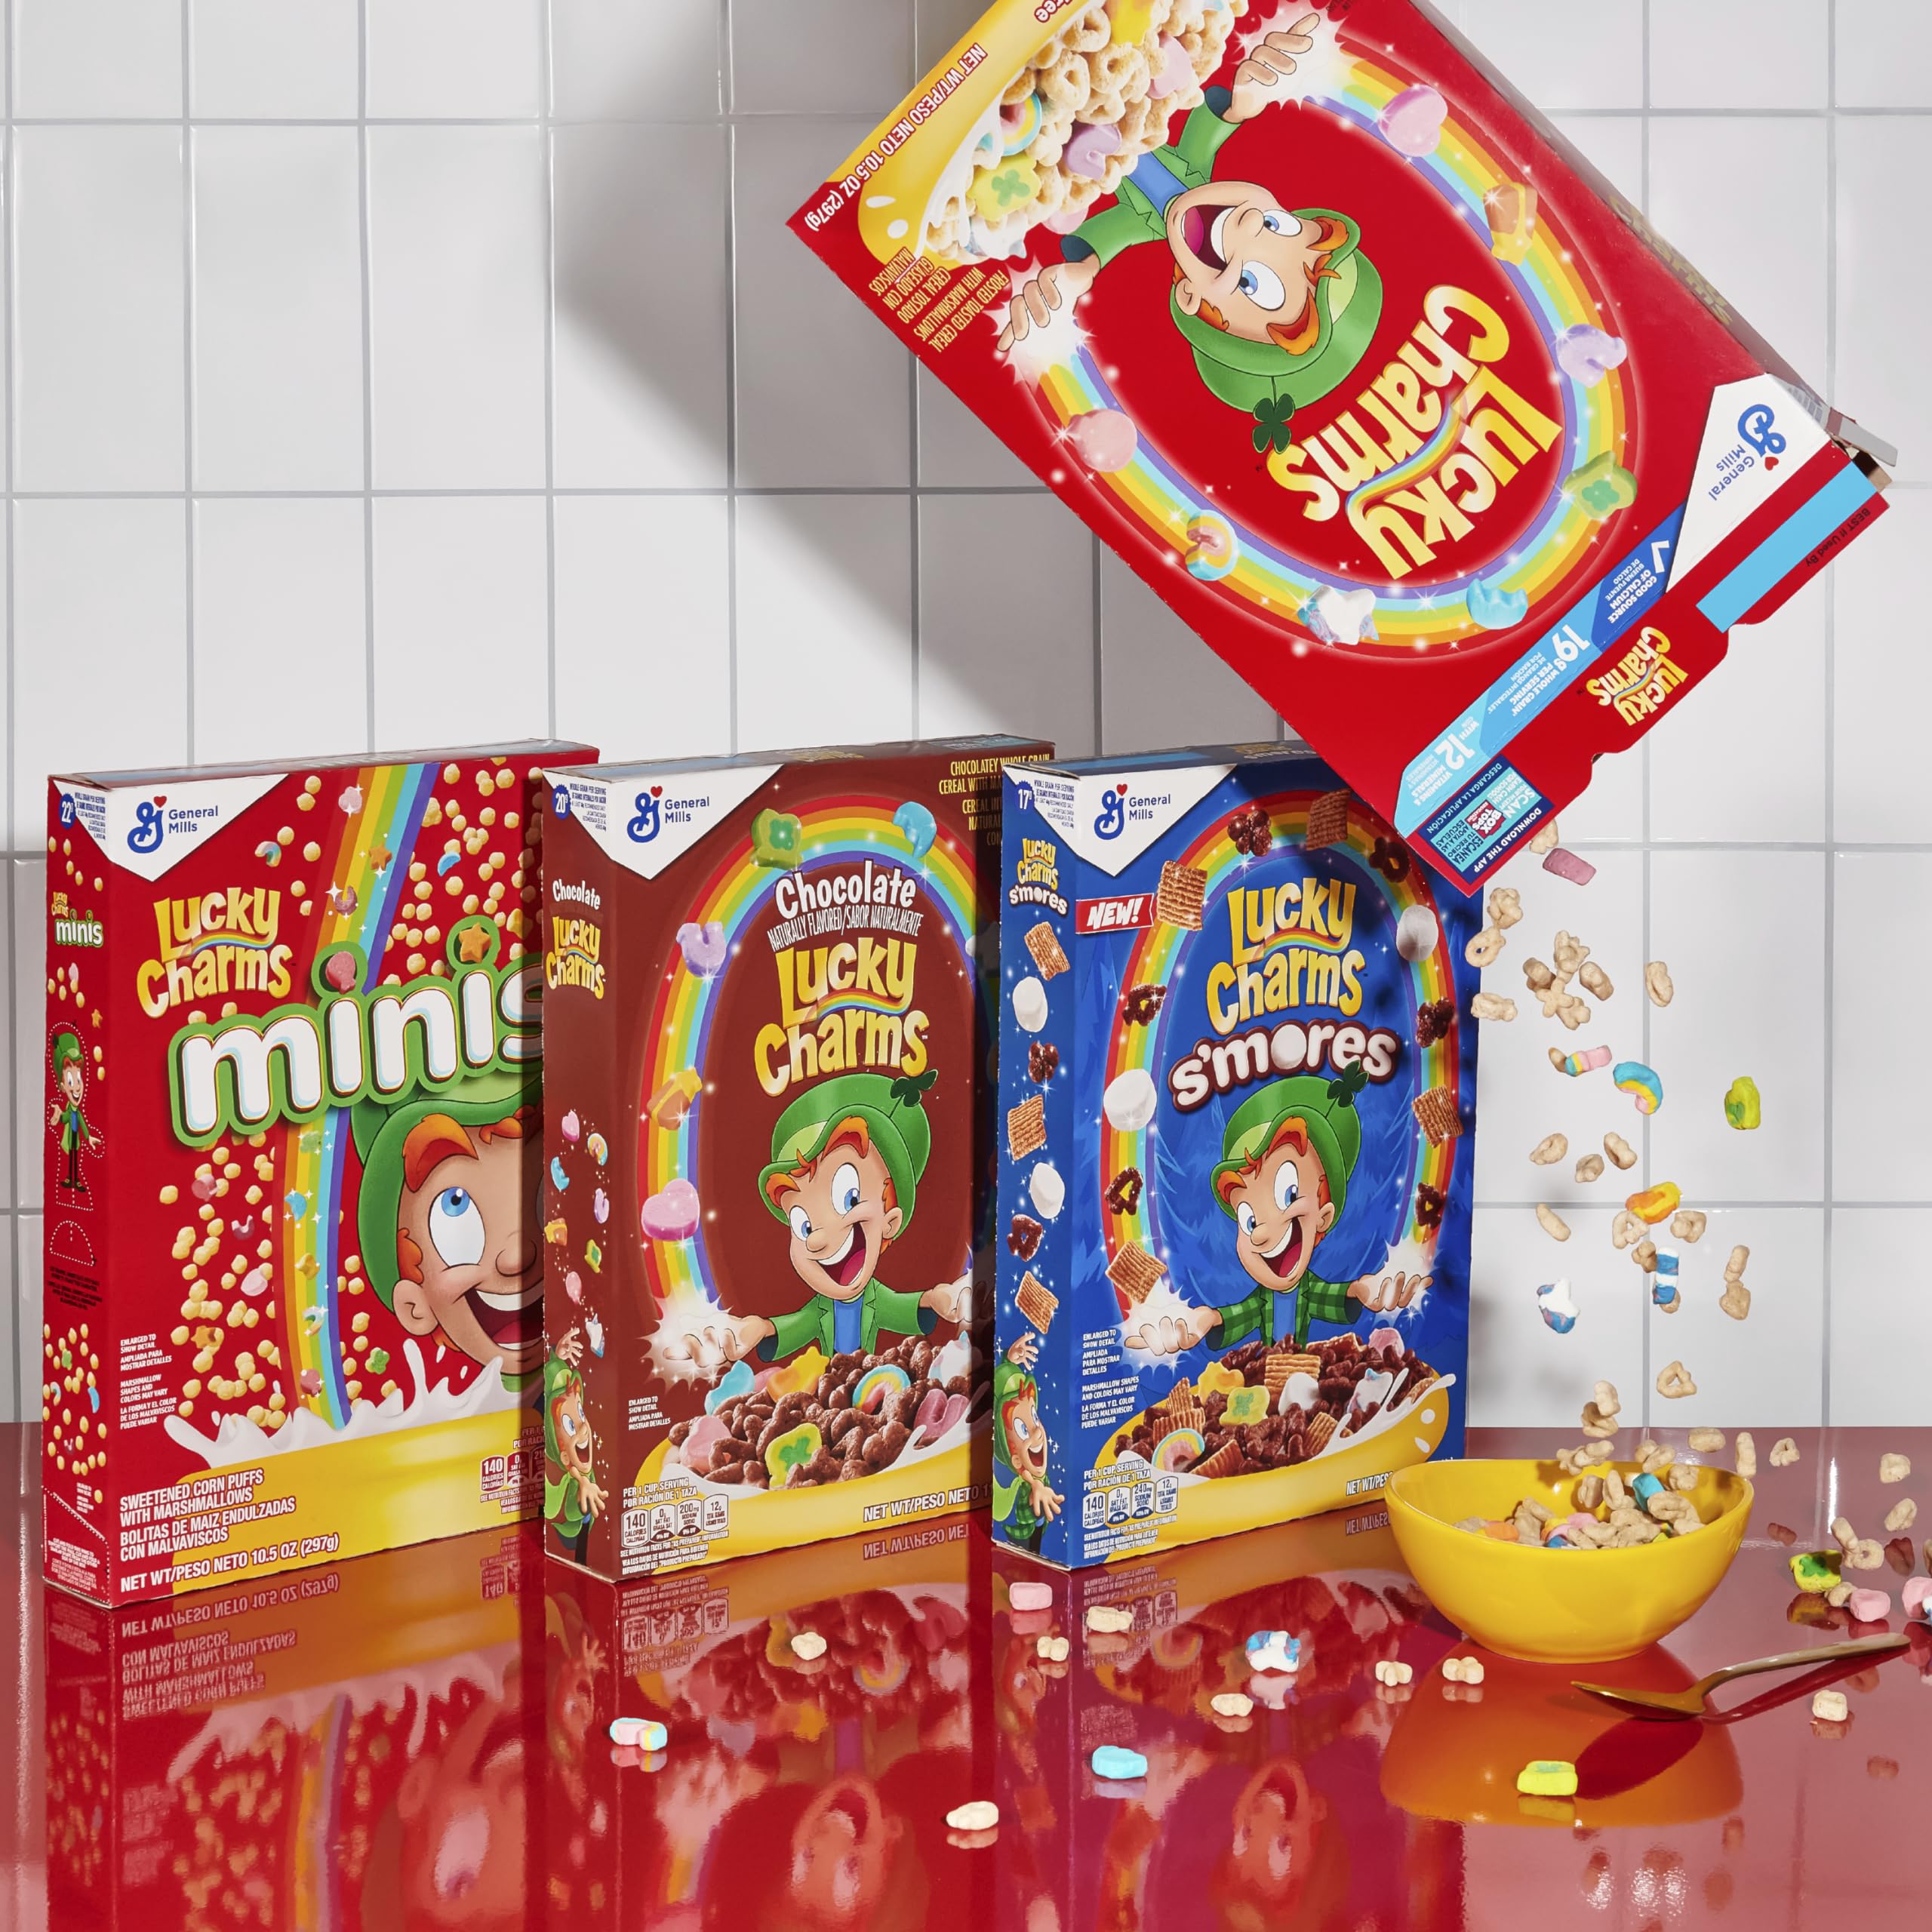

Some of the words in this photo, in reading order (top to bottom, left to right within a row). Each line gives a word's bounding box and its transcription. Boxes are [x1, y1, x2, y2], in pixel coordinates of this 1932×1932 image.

[955, 41, 987, 75] NET
[905, 64, 965, 127] WT/PESO
[876, 116, 915, 157] NETO
[853, 147, 885, 183] 10.5
[836, 171, 863, 199] OZ
[801, 186, 846, 234] (297g)
[866, 246, 915, 297] MALVAVISCOS
[894, 255, 934, 297] GLASEADO
[921, 265, 952, 297] CEREAL
[960, 264, 986, 291] WITH
[974, 268, 1009, 305] FROSTED
[881, 288, 903, 311] CON
[895, 287, 931, 325] TOSTADO
[912, 281, 969, 343] MARSHMALLOWS
[949, 295, 983, 332] TOASTED
[927, 321, 958, 355] CEREAL
[1267, 284, 1510, 522] Charms
[1346, 364, 1563, 580] Lucky
[1715, 443, 1746, 474] Mills
[1707, 454, 1756, 501] General
[1844, 506, 1870, 531] BEST
[1803, 552, 1819, 568] By
[1816, 534, 1841, 557] Used
[1611, 564, 1633, 585] CALCIO
[1623, 561, 1644, 583] BUENA
[1629, 558, 1640, 568] DE
[1638, 568, 1652, 582] OF
[1604, 579, 1627, 601] FUENTE
[1608, 577, 1642, 610] CALCIUM
[1633, 574, 1658, 598] GOOD
[1606, 593, 1638, 623] SOURCE
[1536, 661, 1553, 678] PER
[1586, 626, 1669, 704] Charms
[1507, 673, 1540, 705] SERVING
[1531, 667, 1559, 695] WHOLE
[1614, 652, 1688, 726] Lucky
[1434, 732, 1475, 770] 12
[950, 758, 998, 777] CHOCOLATEY
[1468, 762, 1502, 795] DESCARGA
[939, 778, 967, 795] CEREAL
[968, 777, 988, 792] WITH
[1128, 794, 1171, 807] General
[1460, 791, 1471, 801] LA
[168, 806, 218, 820] General
[664, 796, 709, 810] General
[665, 811, 691, 823] Mills
[1129, 810, 1153, 820] Mills
[1426, 798, 1463, 835] APLICACIÓN
[1470, 805, 1493, 831] TOPS
[1501, 786, 1536, 820] SCAN
[168, 822, 198, 834] Mills
[1435, 819, 1465, 848] ESCUELAS
[1466, 830, 1475, 840] TU
[1478, 807, 1502, 835] BOX
[1499, 806, 1542, 848] DOWNLOAD
[1023, 838, 1057, 868] Lucky
[1446, 837, 1468, 858] RECIBO
[1451, 835, 1483, 866] ESCANEA
[1484, 843, 1502, 860] THE
[1017, 860, 1059, 891] Charms
[1471, 856, 1488, 873] APP
[53, 891, 68, 906] Lucky
[552, 878, 601, 910] Chocolate
[775, 860, 916, 919] Chocolate
[1009, 884, 1068, 915] s'mores
[51, 903, 69, 918] Charms
[153, 887, 281, 963] Lucky
[1086, 897, 1144, 930] NEW!
[1227, 878, 1357, 967] Lucky
[55, 910, 103, 944] minis
[552, 916, 600, 964] Lucky
[767, 914, 808, 952] NATURALLY
[870, 905, 924, 937] NATURALMENTE
[137, 944, 293, 1018] Charms
[546, 951, 605, 1000] Charms
[775, 937, 918, 1029] Lucky
[1206, 948, 1366, 1035] Charms
[754, 1010, 929, 1097] Charms
[1172, 1024, 1397, 1106] s'mores
[1083, 1331, 1109, 1341] ENLARGED
[1083, 1340, 1098, 1349] SHOW
[1099, 1338, 1115, 1346] DETAIL
[1083, 1349, 1108, 1359] AMPLIADA
[1083, 1359, 1096, 1367] PARA
[1097, 1355, 1120, 1365] MOSTRAR
[1082, 1366, 1107, 1376] DETALLES
[1082, 1380, 1121, 1392] MARSHMALLOW
[1121, 1376, 1139, 1385] SHAPES
[1082, 1392, 1093, 1401] AND
[1094, 1389, 1112, 1398] COLORS
[1124, 1385, 1138, 1393] VARY
[482, 1473, 503, 1482] CALORIES
[484, 1459, 503, 1475] 140
[1084, 1469, 1097, 1480] PER
[1103, 1466, 1116, 1475] CUP
[1116, 1460, 1143, 1473] SERVING
[1084, 1481, 1097, 1491] POR
[1098, 1475, 1121, 1488] RACIÓN
[1122, 1473, 1131, 1483] DE
[1136, 1470, 1151, 1480] TAZA
[120, 1484, 189, 1512] SWEETENED
[194, 1476, 225, 1497] CORN
[228, 1469, 263, 1489] PUFFS
[623, 1487, 637, 1497] PER
[638, 1487, 641, 1495] 1
[644, 1483, 658, 1494] CUP
[659, 1477, 689, 1491] SERVING
[623, 1498, 638, 1509] POR
[638, 1493, 664, 1506] RACIÓN
[665, 1491, 674, 1500] DE
[675, 1490, 679, 1498] 1
[681, 1487, 697, 1498] TAZA
[1346, 1480, 1361, 1496] NET
[1361, 1472, 1393, 1492] WT/PES
[120, 1510, 150, 1527] WITH
[153, 1487, 253, 1519] MARSHMALLOWS
[863, 1504, 888, 1522] NET
[891, 1492, 945, 1516] WT/PESO
[948, 1486, 980, 1505] NETO
[1084, 1511, 1104, 1520] CALORIES
[1086, 1495, 1103, 1512] 140
[121, 1523, 169, 1546] BOLITAS
[172, 1519, 187, 1534] DE
[190, 1512, 219, 1531] MAIZ
[222, 1497, 295, 1525] ENDULZADAS
[624, 1528, 646, 1538] CALORIES
[626, 1513, 645, 1530] 140
[121, 1545, 145, 1562] CON
[148, 1527, 228, 1556] MALVAVISCOS
[121, 1574, 146, 1592] NET
[151, 1560, 210, 1586] WT/PESO
[214, 1552, 248, 1573] NETO
[251, 1546, 277, 1565] 10.5
[281, 1541, 297, 1558] OZ
[300, 1534, 339, 1557] (297g)
